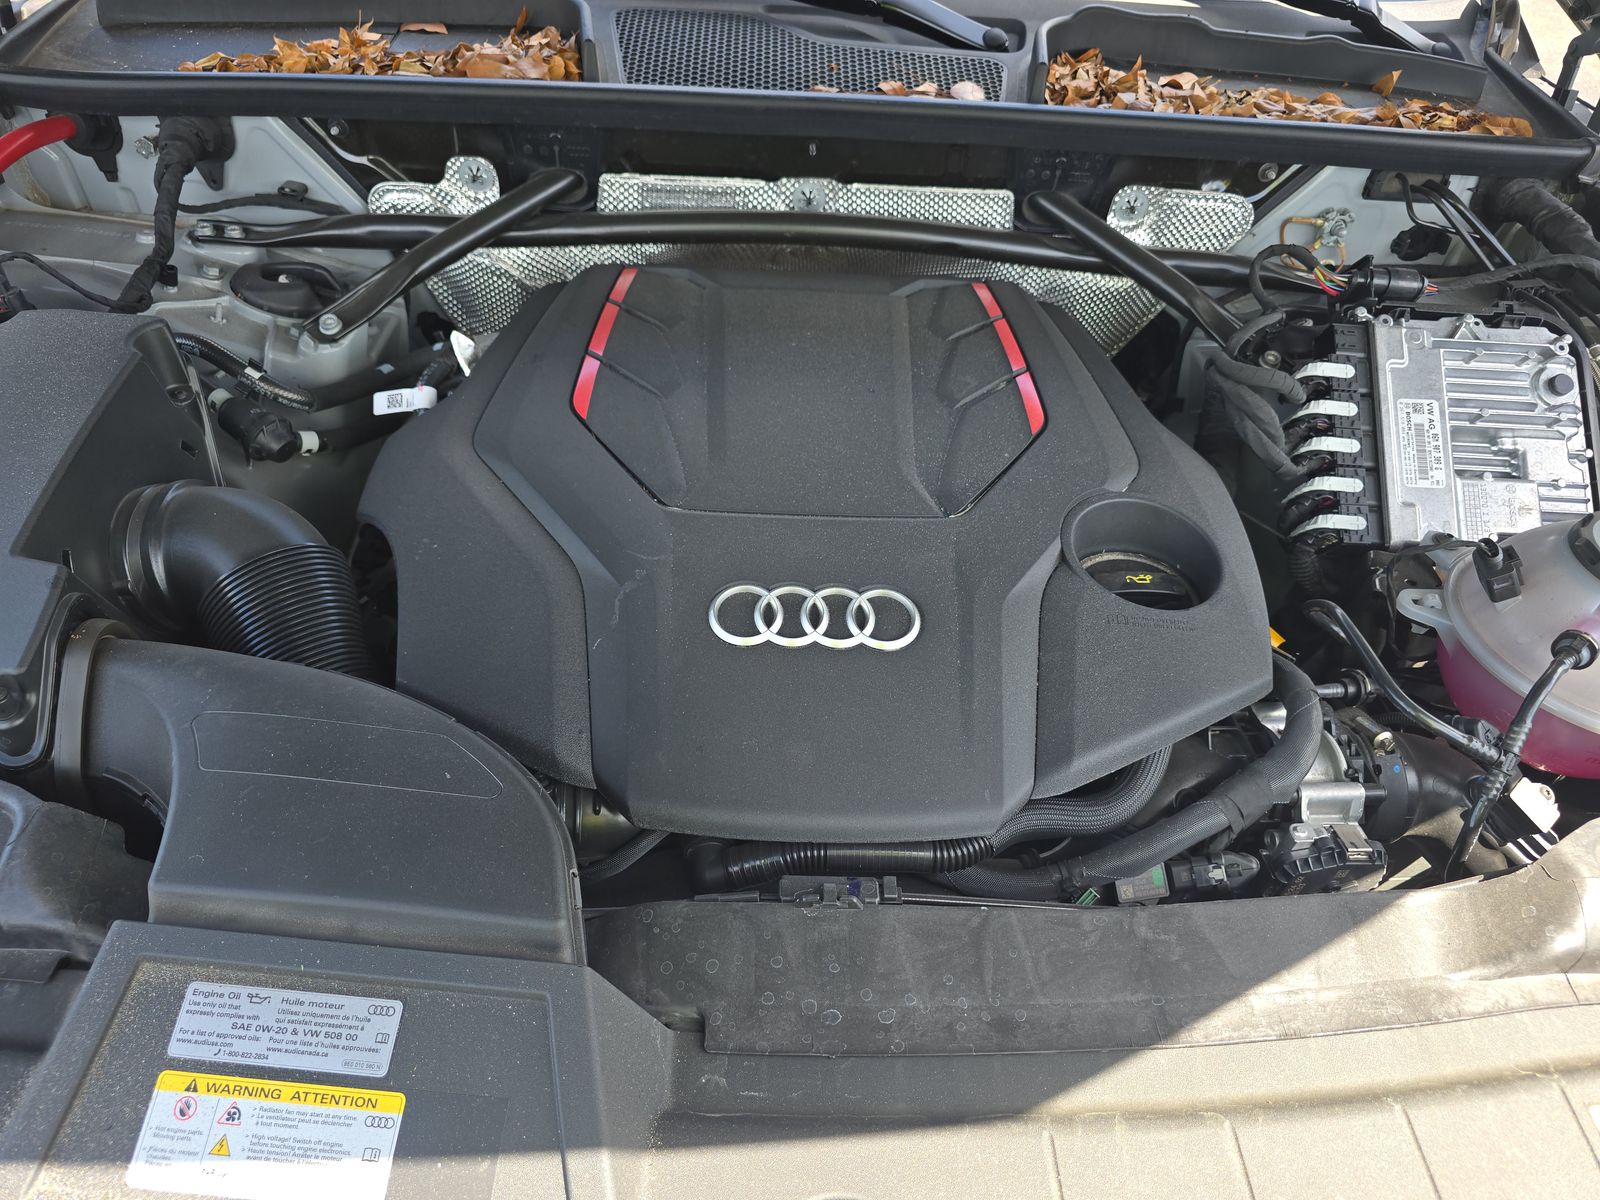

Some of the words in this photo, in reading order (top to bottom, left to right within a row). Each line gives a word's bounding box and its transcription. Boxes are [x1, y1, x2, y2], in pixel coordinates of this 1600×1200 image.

[1427, 402, 1434, 416] VW
[1428, 418, 1435, 430] AG
[192, 988, 225, 999] Engine
[228, 991, 242, 1000] Oil
[202, 1000, 217, 1009] only
[281, 997, 305, 1006] Huile
[308, 1000, 345, 1010] moteur
[185, 1009, 215, 1018] expressly
[216, 1011, 245, 1020] complies
[278, 1008, 301, 1016] Utilisez
[302, 1011, 340, 1020] uniquement
[351, 1014, 372, 1023] l'huile
[286, 1018, 313, 1026] satisfait
[314, 1020, 360, 1030] expressément
[178, 1027, 190, 1035] For
[216, 1032, 246, 1041] approved
[231, 1022, 254, 1032] SAE
[255, 1024, 288, 1035] 0W-20
[290, 1028, 300, 1036] &
[303, 1028, 322, 1038] VW
[324, 1031, 343, 1040] 508
[345, 1032, 358, 1041] 00
[176, 1038, 234, 1048] www.audiusa.com
[268, 1036, 284, 1044] Pour
[299, 1039, 313, 1048] liste
[341, 1044, 382, 1054] approuvées:
[223, 1050, 269, 1060] 1-800-822-2834
[266, 1047, 329, 1058] www.audicanada.ca
[206, 1082, 282, 1100] WARNING
[290, 1090, 378, 1110] ATTENTION
[258, 1106, 284, 1115] Radiator
[297, 1110, 309, 1118] may
[266, 1114, 297, 1123] ventilateur
[298, 1117, 312, 1125] peut
[251, 1134, 266, 1142] High
[292, 1137, 314, 1146] Switch
[250, 1140, 269, 1148] before
[270, 1142, 296, 1152] touching
[297, 1146, 318, 1154] engine
